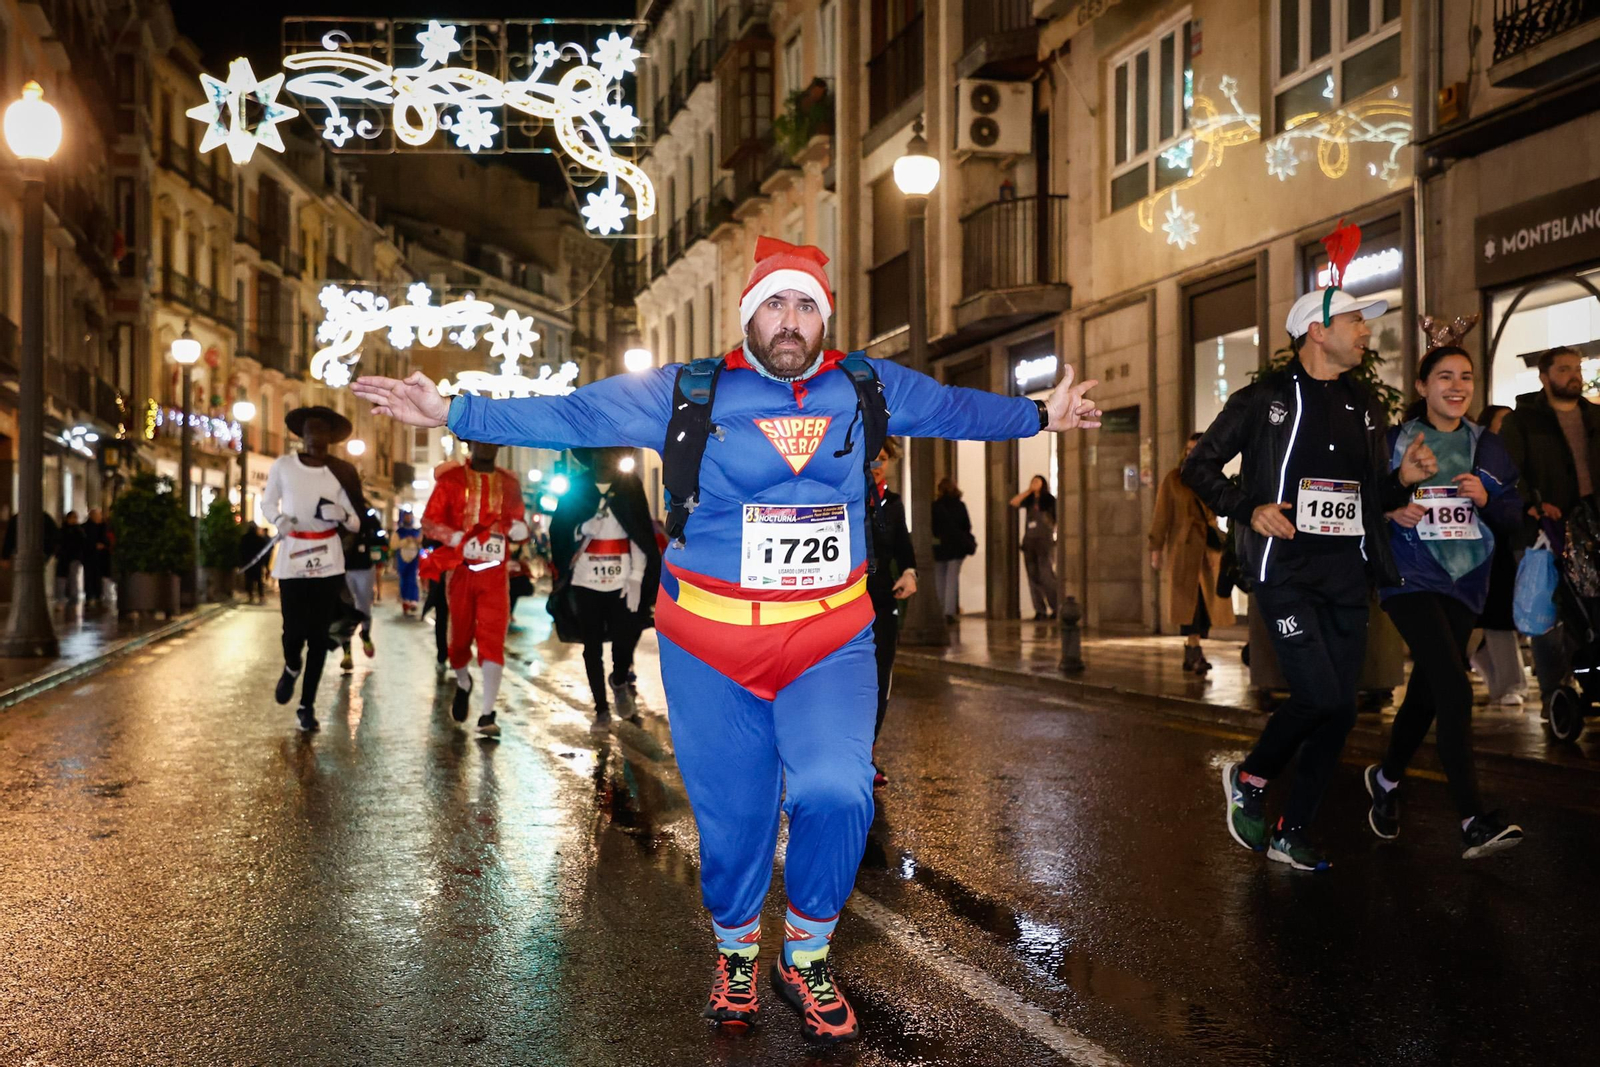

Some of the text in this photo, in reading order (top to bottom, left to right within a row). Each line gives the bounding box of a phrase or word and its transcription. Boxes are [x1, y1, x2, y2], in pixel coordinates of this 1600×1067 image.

[759, 418, 827, 439] SUPER
[772, 437, 820, 454] HERO
[1302, 480, 1311, 490] 33
[1307, 500, 1356, 520] 1868
[1425, 506, 1474, 524] 1867
[759, 514, 797, 523] NOCTURNA
[470, 541, 501, 554] 1163
[757, 536, 839, 564] 1726
[305, 557, 322, 569] 42
[593, 565, 622, 576] 1169
